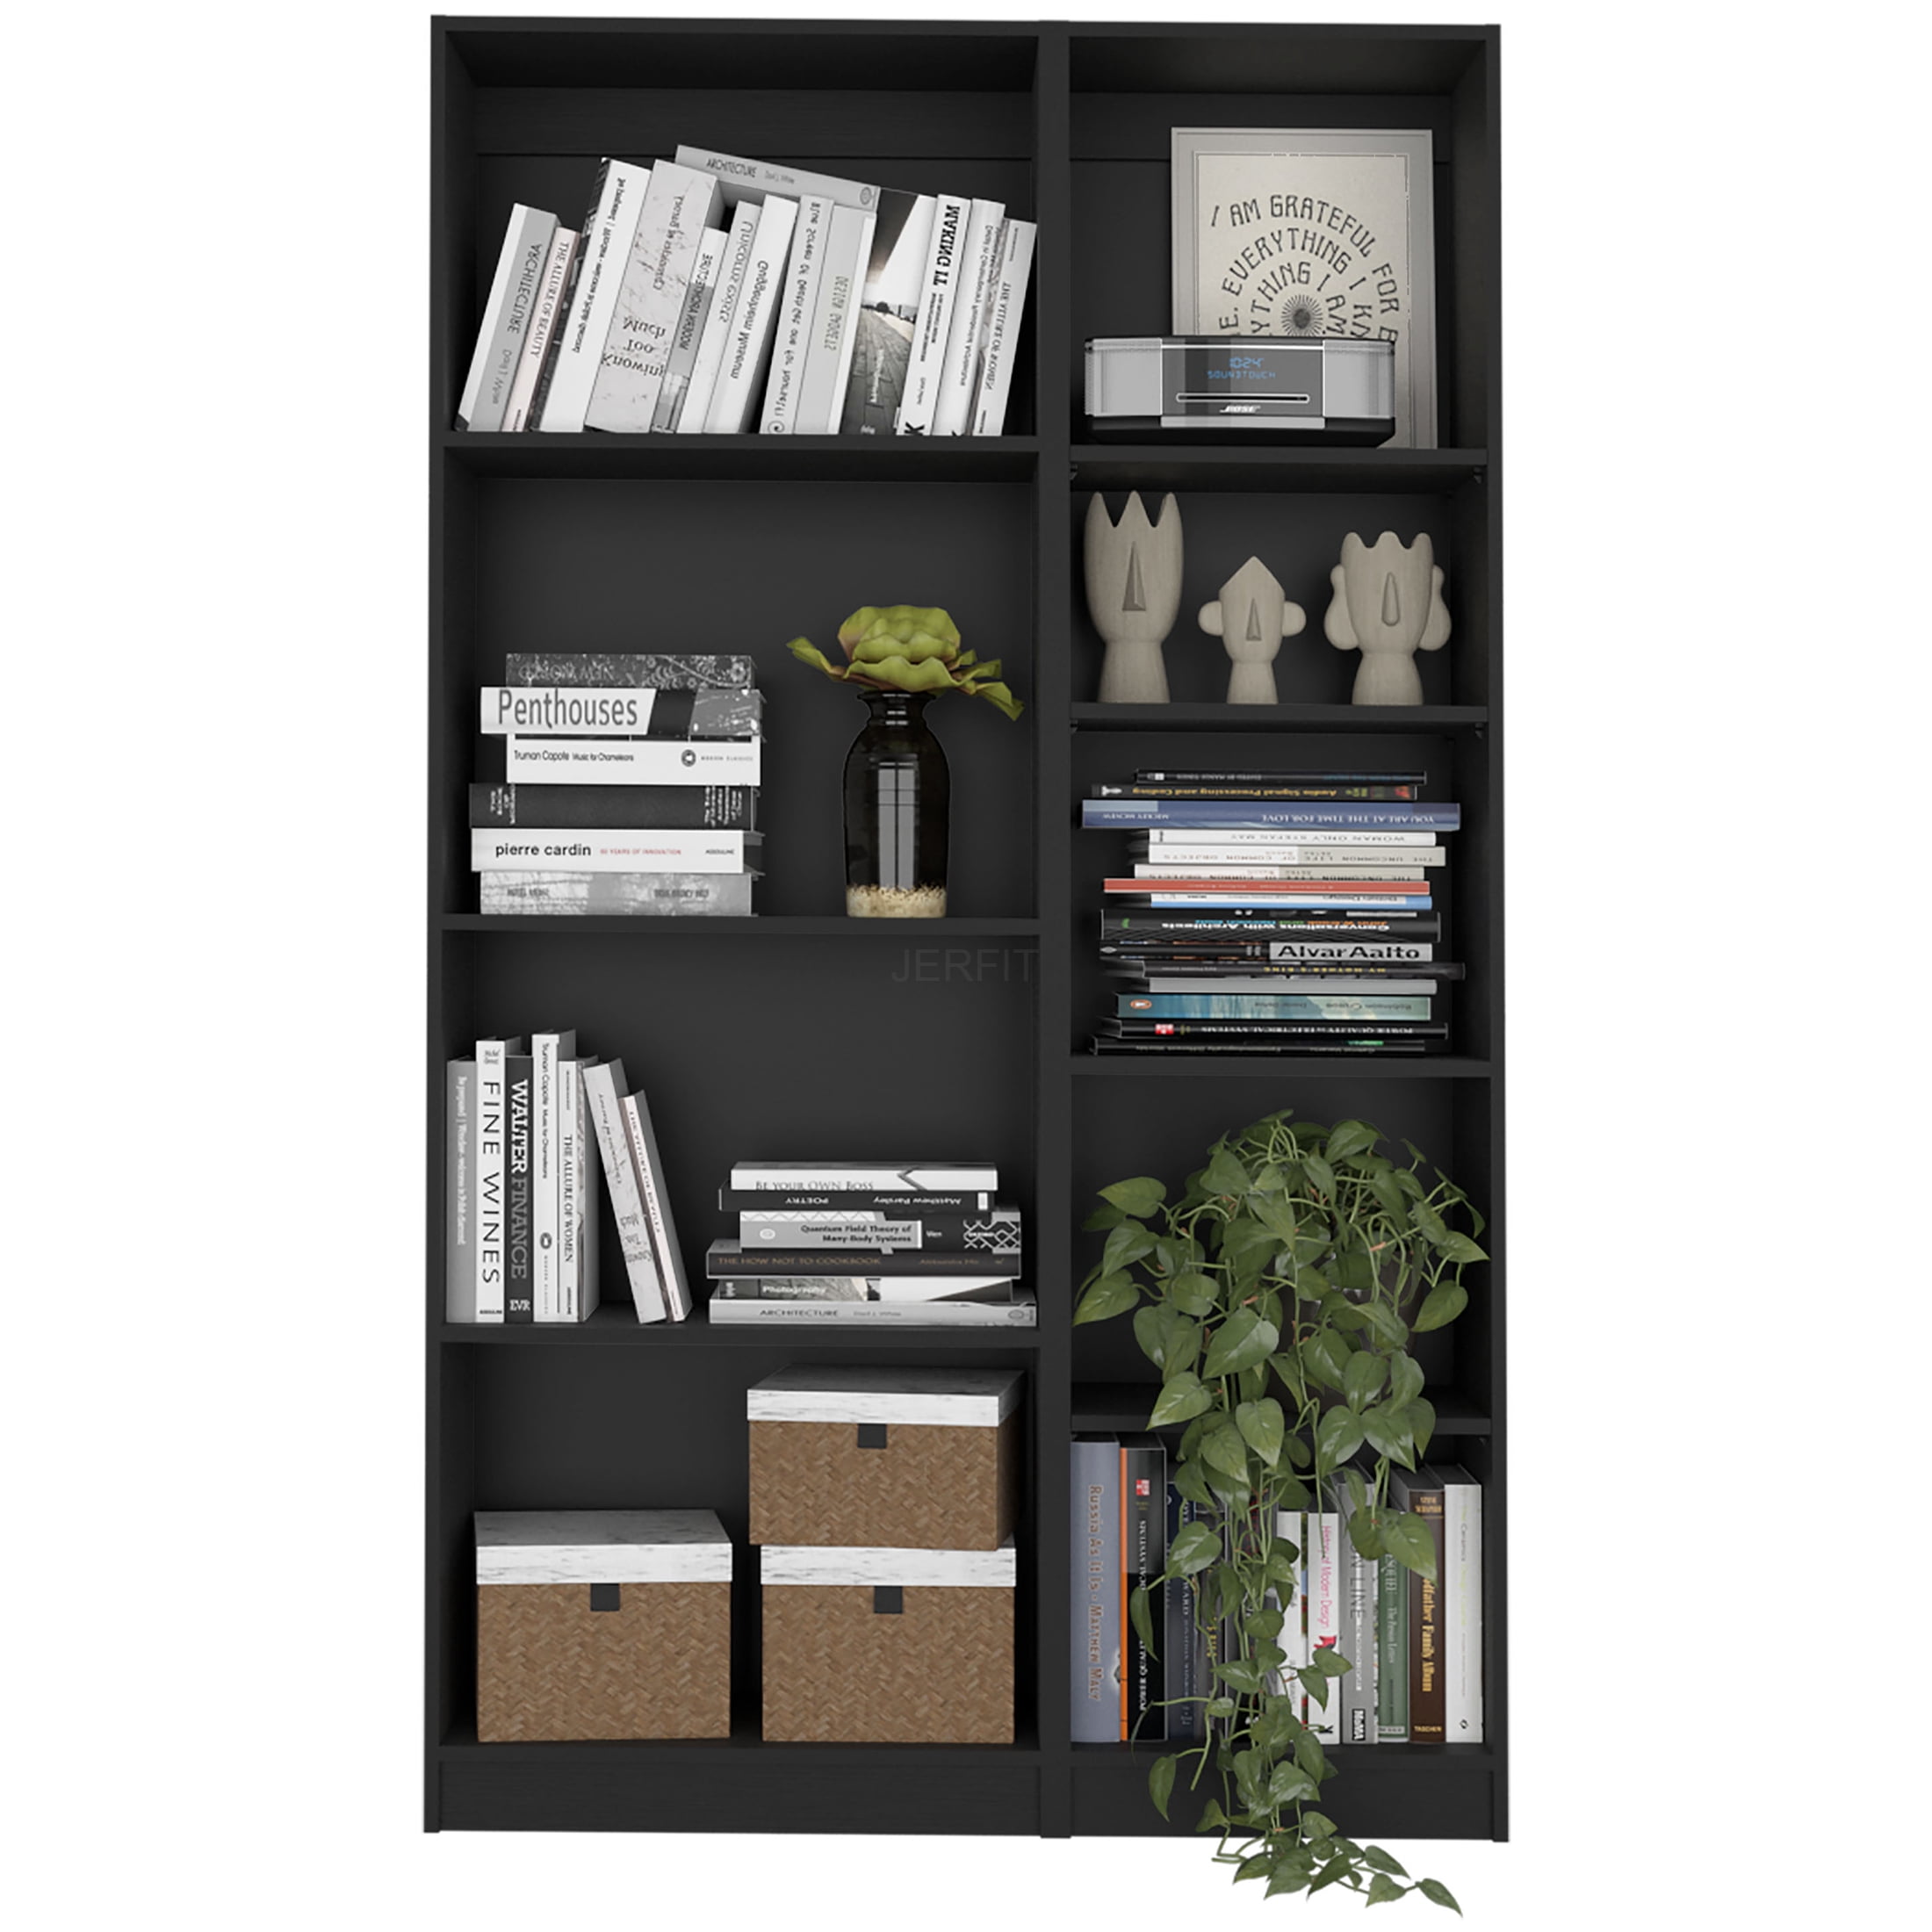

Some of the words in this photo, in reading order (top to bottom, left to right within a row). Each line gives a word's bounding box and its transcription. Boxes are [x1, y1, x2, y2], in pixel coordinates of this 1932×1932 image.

[553, 241, 570, 263] THE
[1212, 205, 1220, 227] I
[1229, 198, 1261, 227] AM
[1270, 194, 1376, 257] GRATEFUL
[1373, 263, 1399, 314] FOR
[1222, 227, 1352, 296] EVERYTHING
[1349, 277, 1366, 290] I
[543, 262, 564, 303] ALLURE
[539, 300, 553, 315] OF
[1251, 262, 1311, 333] YTHING
[1317, 274, 1330, 292] I
[528, 315, 549, 357] BEAUTY
[497, 688, 638, 729] Penthouses
[513, 749, 541, 761] Truman
[541, 750, 570, 761] Capote
[1131, 786, 1172, 795] Coding
[1200, 787, 1261, 796] Processing
[1261, 813, 1288, 822] LOVE
[1290, 813, 1314, 822] FOR
[1348, 814, 1367, 823] THE
[1372, 814, 1385, 823] AT
[1388, 814, 1408, 823] ARE
[494, 841, 539, 858] pierre
[544, 841, 591, 856] cardin
[1325, 1001, 1362, 1010] Crusoe
[541, 1074, 550, 1105] Capote
[482, 1082, 499, 1154] FINE
[564, 1134, 573, 1157] THE
[564, 1158, 573, 1200] ALLURE
[755, 1179, 767, 1189] BE
[772, 1179, 803, 1190] YOUR
[806, 1179, 839, 1191] OWN
[845, 1180, 874, 1192] BOSS
[564, 1203, 573, 1215] OF
[482, 1171, 499, 1283] WINES
[510, 1177, 527, 1279] FINANCE
[800, 1224, 842, 1233] Quantum
[869, 1224, 899, 1234] Theory
[564, 1219, 573, 1261] WOMEN
[875, 1234, 911, 1244] Systems
[762, 1285, 826, 1294] Photography
[1089, 1484, 1103, 1532] Russia
[1089, 1538, 1103, 1555] As
[1320, 1525, 1331, 1554] History
[1089, 1560, 1103, 1573] It
[1089, 1575, 1103, 1591] Is
[1321, 1566, 1331, 1596] Modern
[1319, 1599, 1332, 1627] Design
[1422, 1626, 1434, 1658] Family
[1422, 1661, 1435, 1691] Album
[1139, 1677, 1148, 1710] POWER
